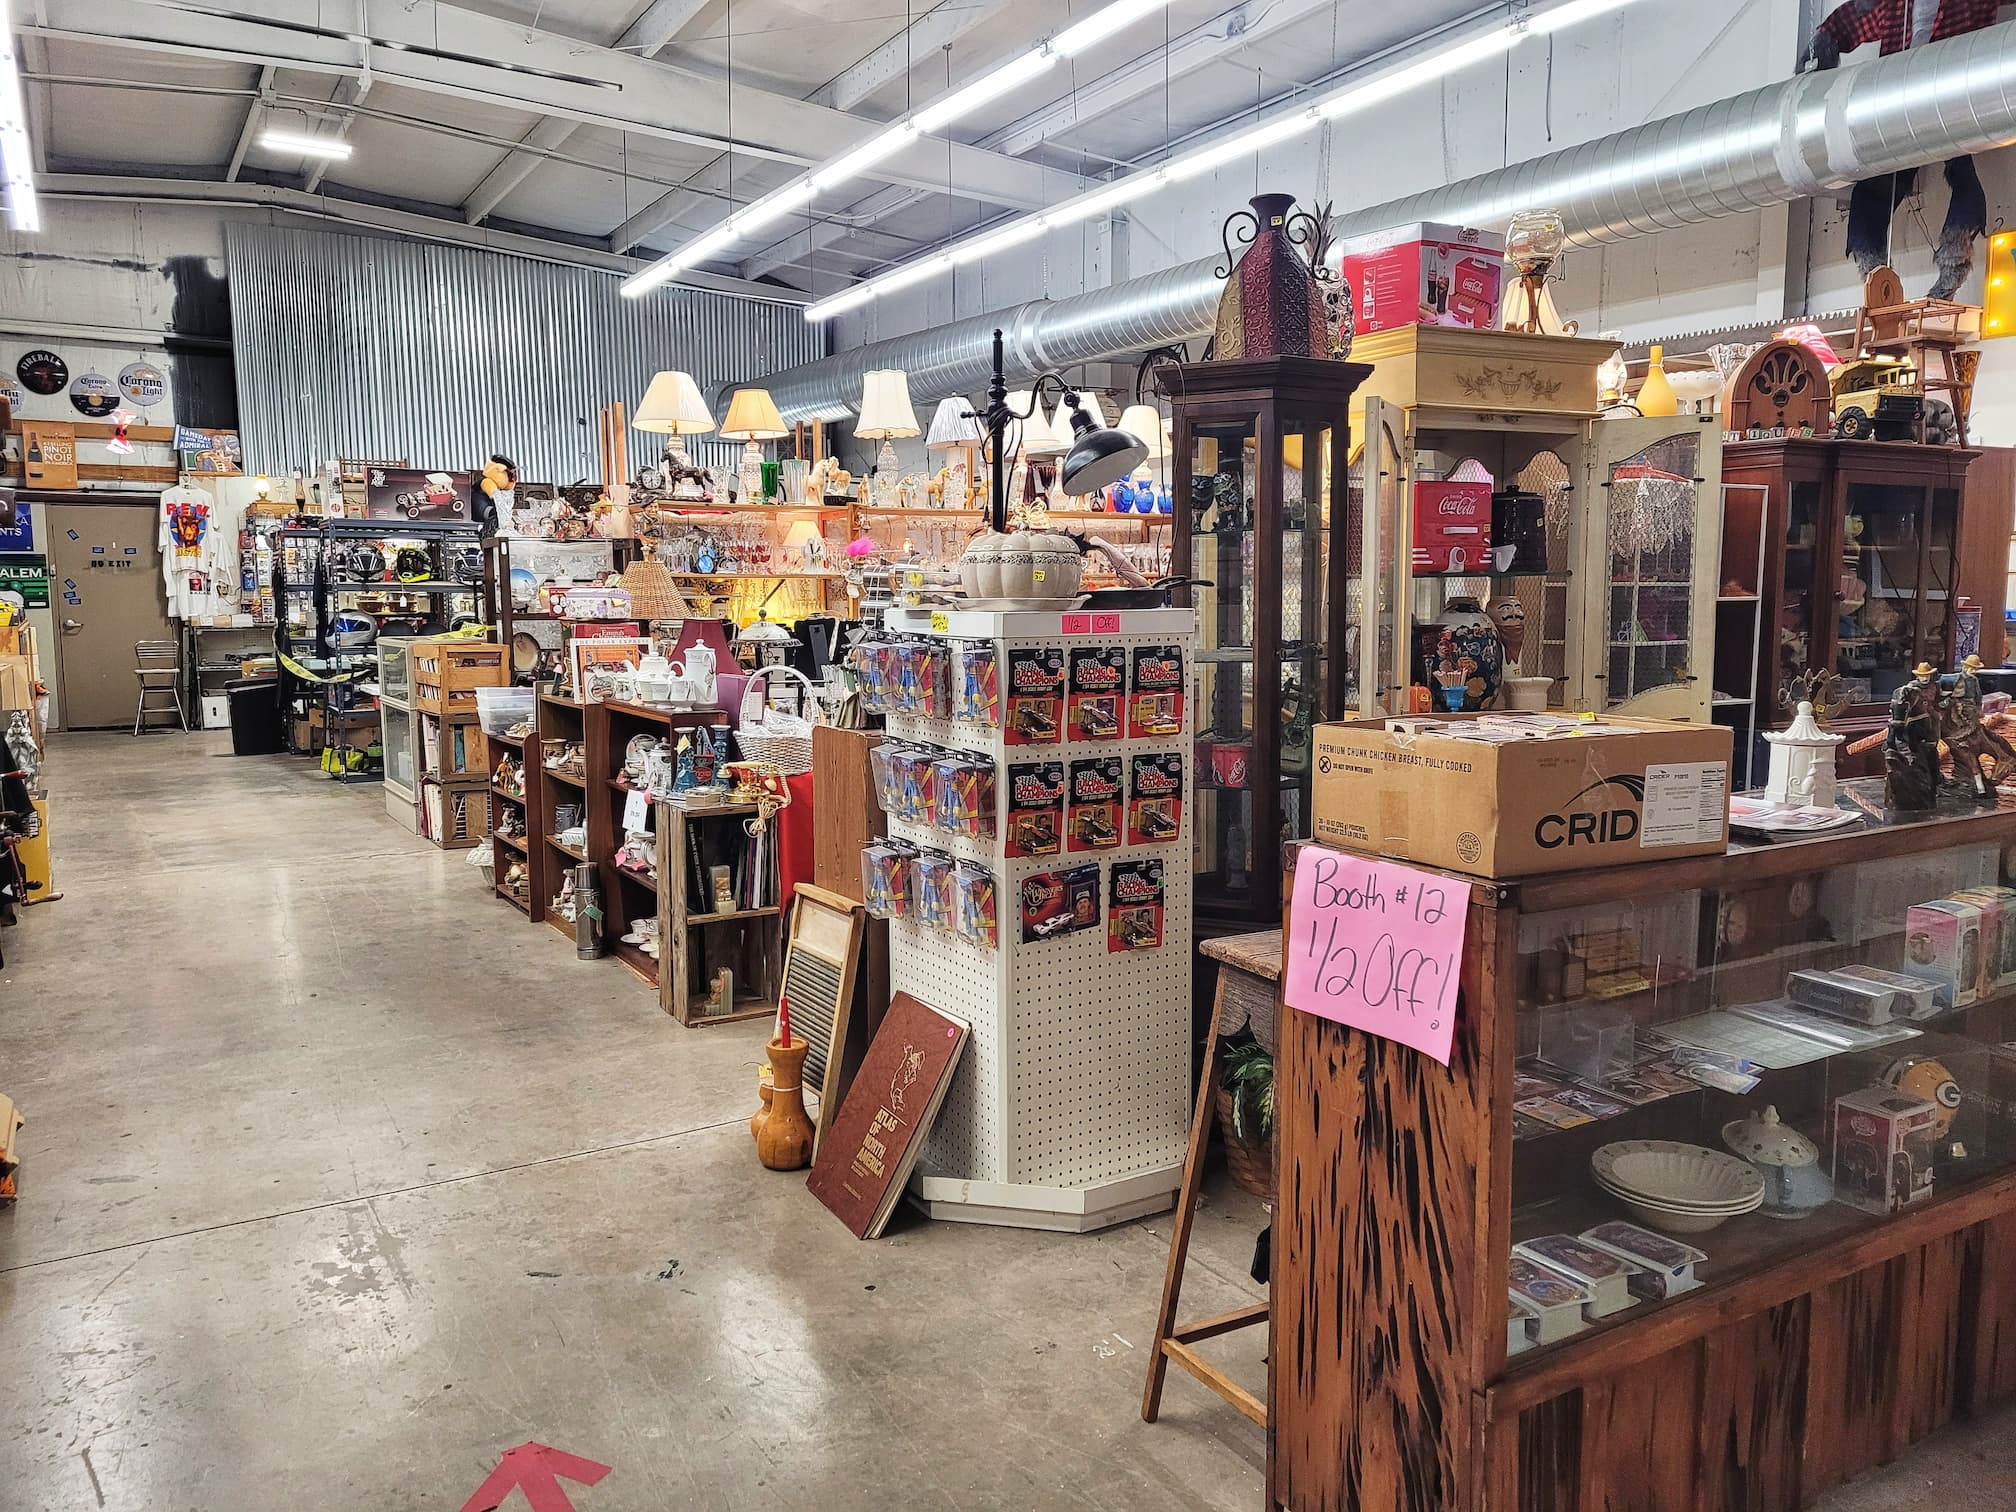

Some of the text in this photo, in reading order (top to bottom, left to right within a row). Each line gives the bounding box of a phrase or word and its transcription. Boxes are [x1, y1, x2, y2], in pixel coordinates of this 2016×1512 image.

[120, 375, 163, 389] Corona
[142, 386, 163, 396] Light
[43, 446, 73, 454] PINOT
[180, 441, 210, 449] ADMIRAL
[44, 453, 73, 463] NOIR
[108, 560, 132, 568] EXIT
[1068, 616, 1116, 632] 1/2 Off!
[1016, 669, 1044, 678] RACING
[1077, 667, 1105, 676] RACING
[1138, 670, 1180, 681] CHAMPIONS
[1015, 676, 1058, 686] CHAMPIONS
[1319, 743, 1472, 773] PREMIUM CHUNK CHICKEN BREAST, FULLY COOKED
[1345, 764, 1354, 772] OPEN
[1354, 765, 1363, 773] WITH
[1077, 778, 1104, 787] RACING
[1138, 773, 1165, 782] RACING
[1017, 784, 1045, 792] RACING
[1138, 779, 1178, 788] CHAMPIONS
[1077, 784, 1118, 794] CHAMPIONS
[1017, 790, 1058, 799] CHAMPIONS
[1534, 809, 1639, 849] CRID
[1118, 880, 1146, 889] RACING
[1313, 857, 1385, 914] Booth
[1118, 886, 1159, 896] CHAMPIONS
[1308, 915, 1454, 1031] 1/2 Off!
[1937, 1080, 1961, 1107] G
[874, 1108, 898, 1133] ATLAS
[868, 1120, 882, 1137] OF
[862, 1132, 887, 1161] NORTH
[856, 1146, 886, 1179] AMERICA
